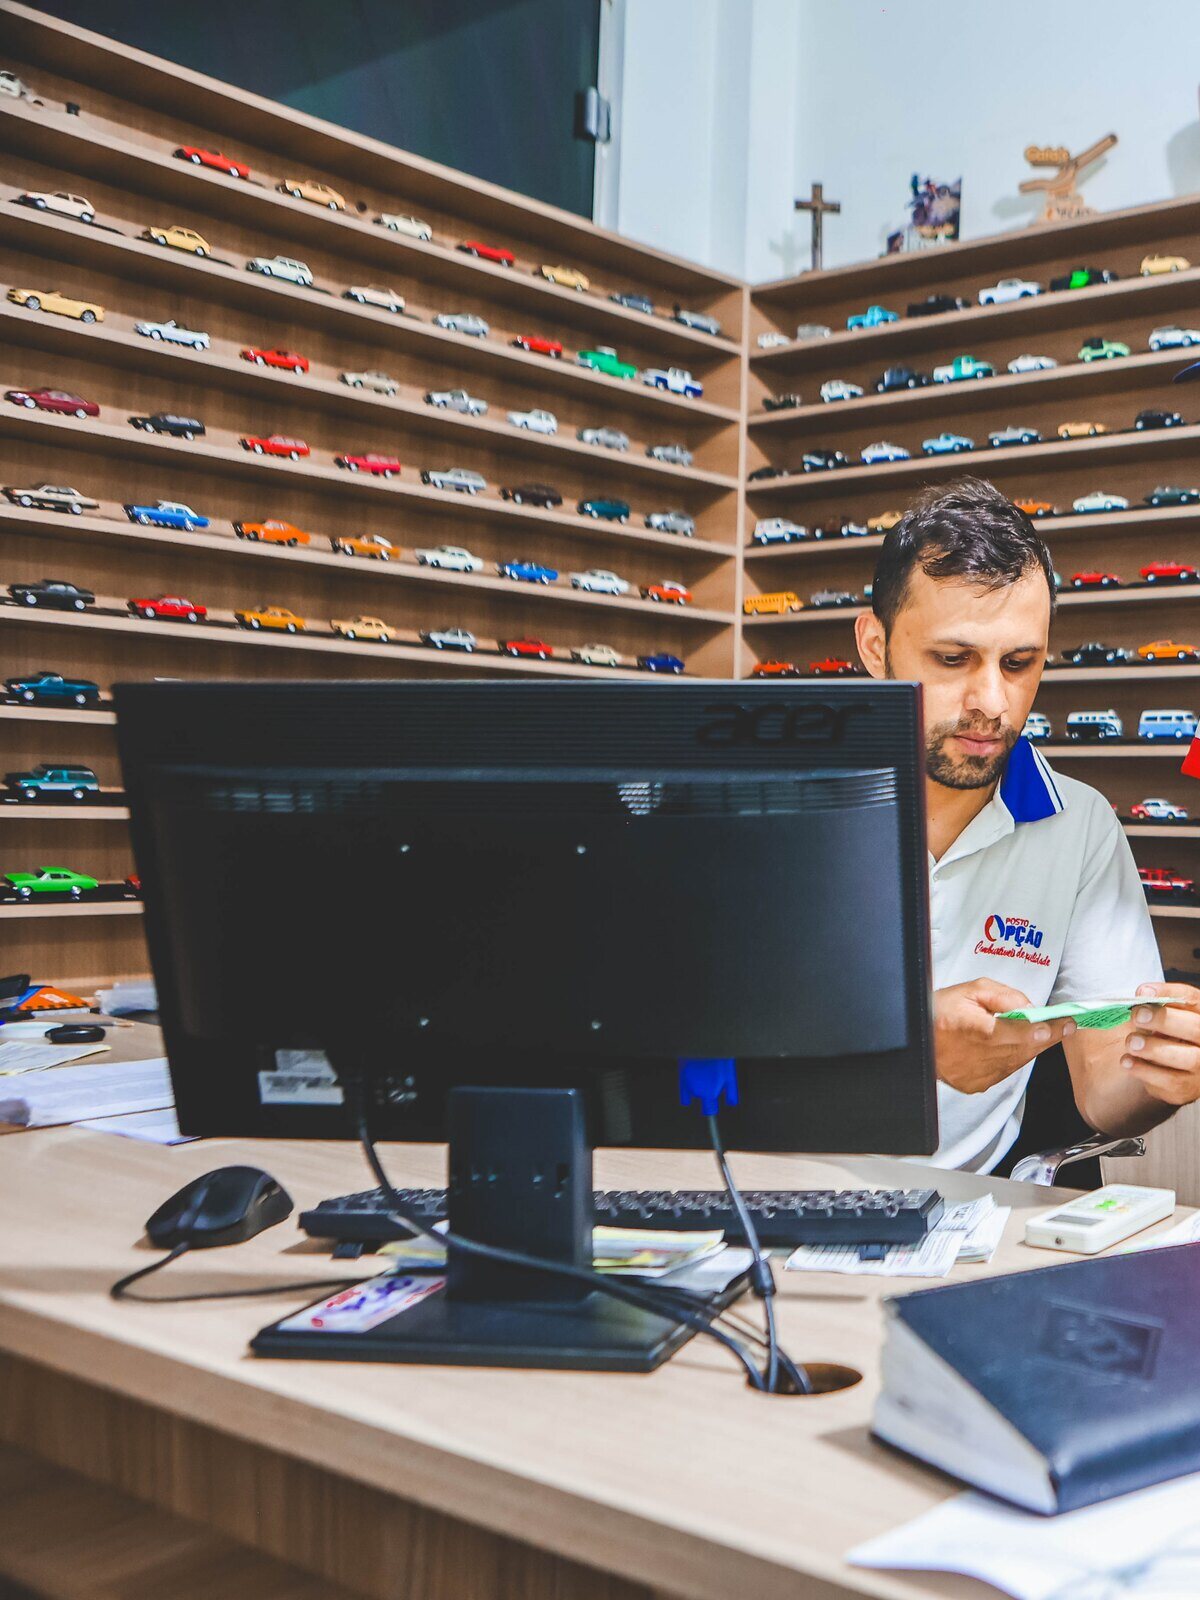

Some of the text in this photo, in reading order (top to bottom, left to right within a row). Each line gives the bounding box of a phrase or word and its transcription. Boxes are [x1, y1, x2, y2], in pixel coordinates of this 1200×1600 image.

[696, 703, 873, 747] acer
[984, 914, 1043, 949] OPÇÃO
[1005, 917, 1029, 928] POSTO
